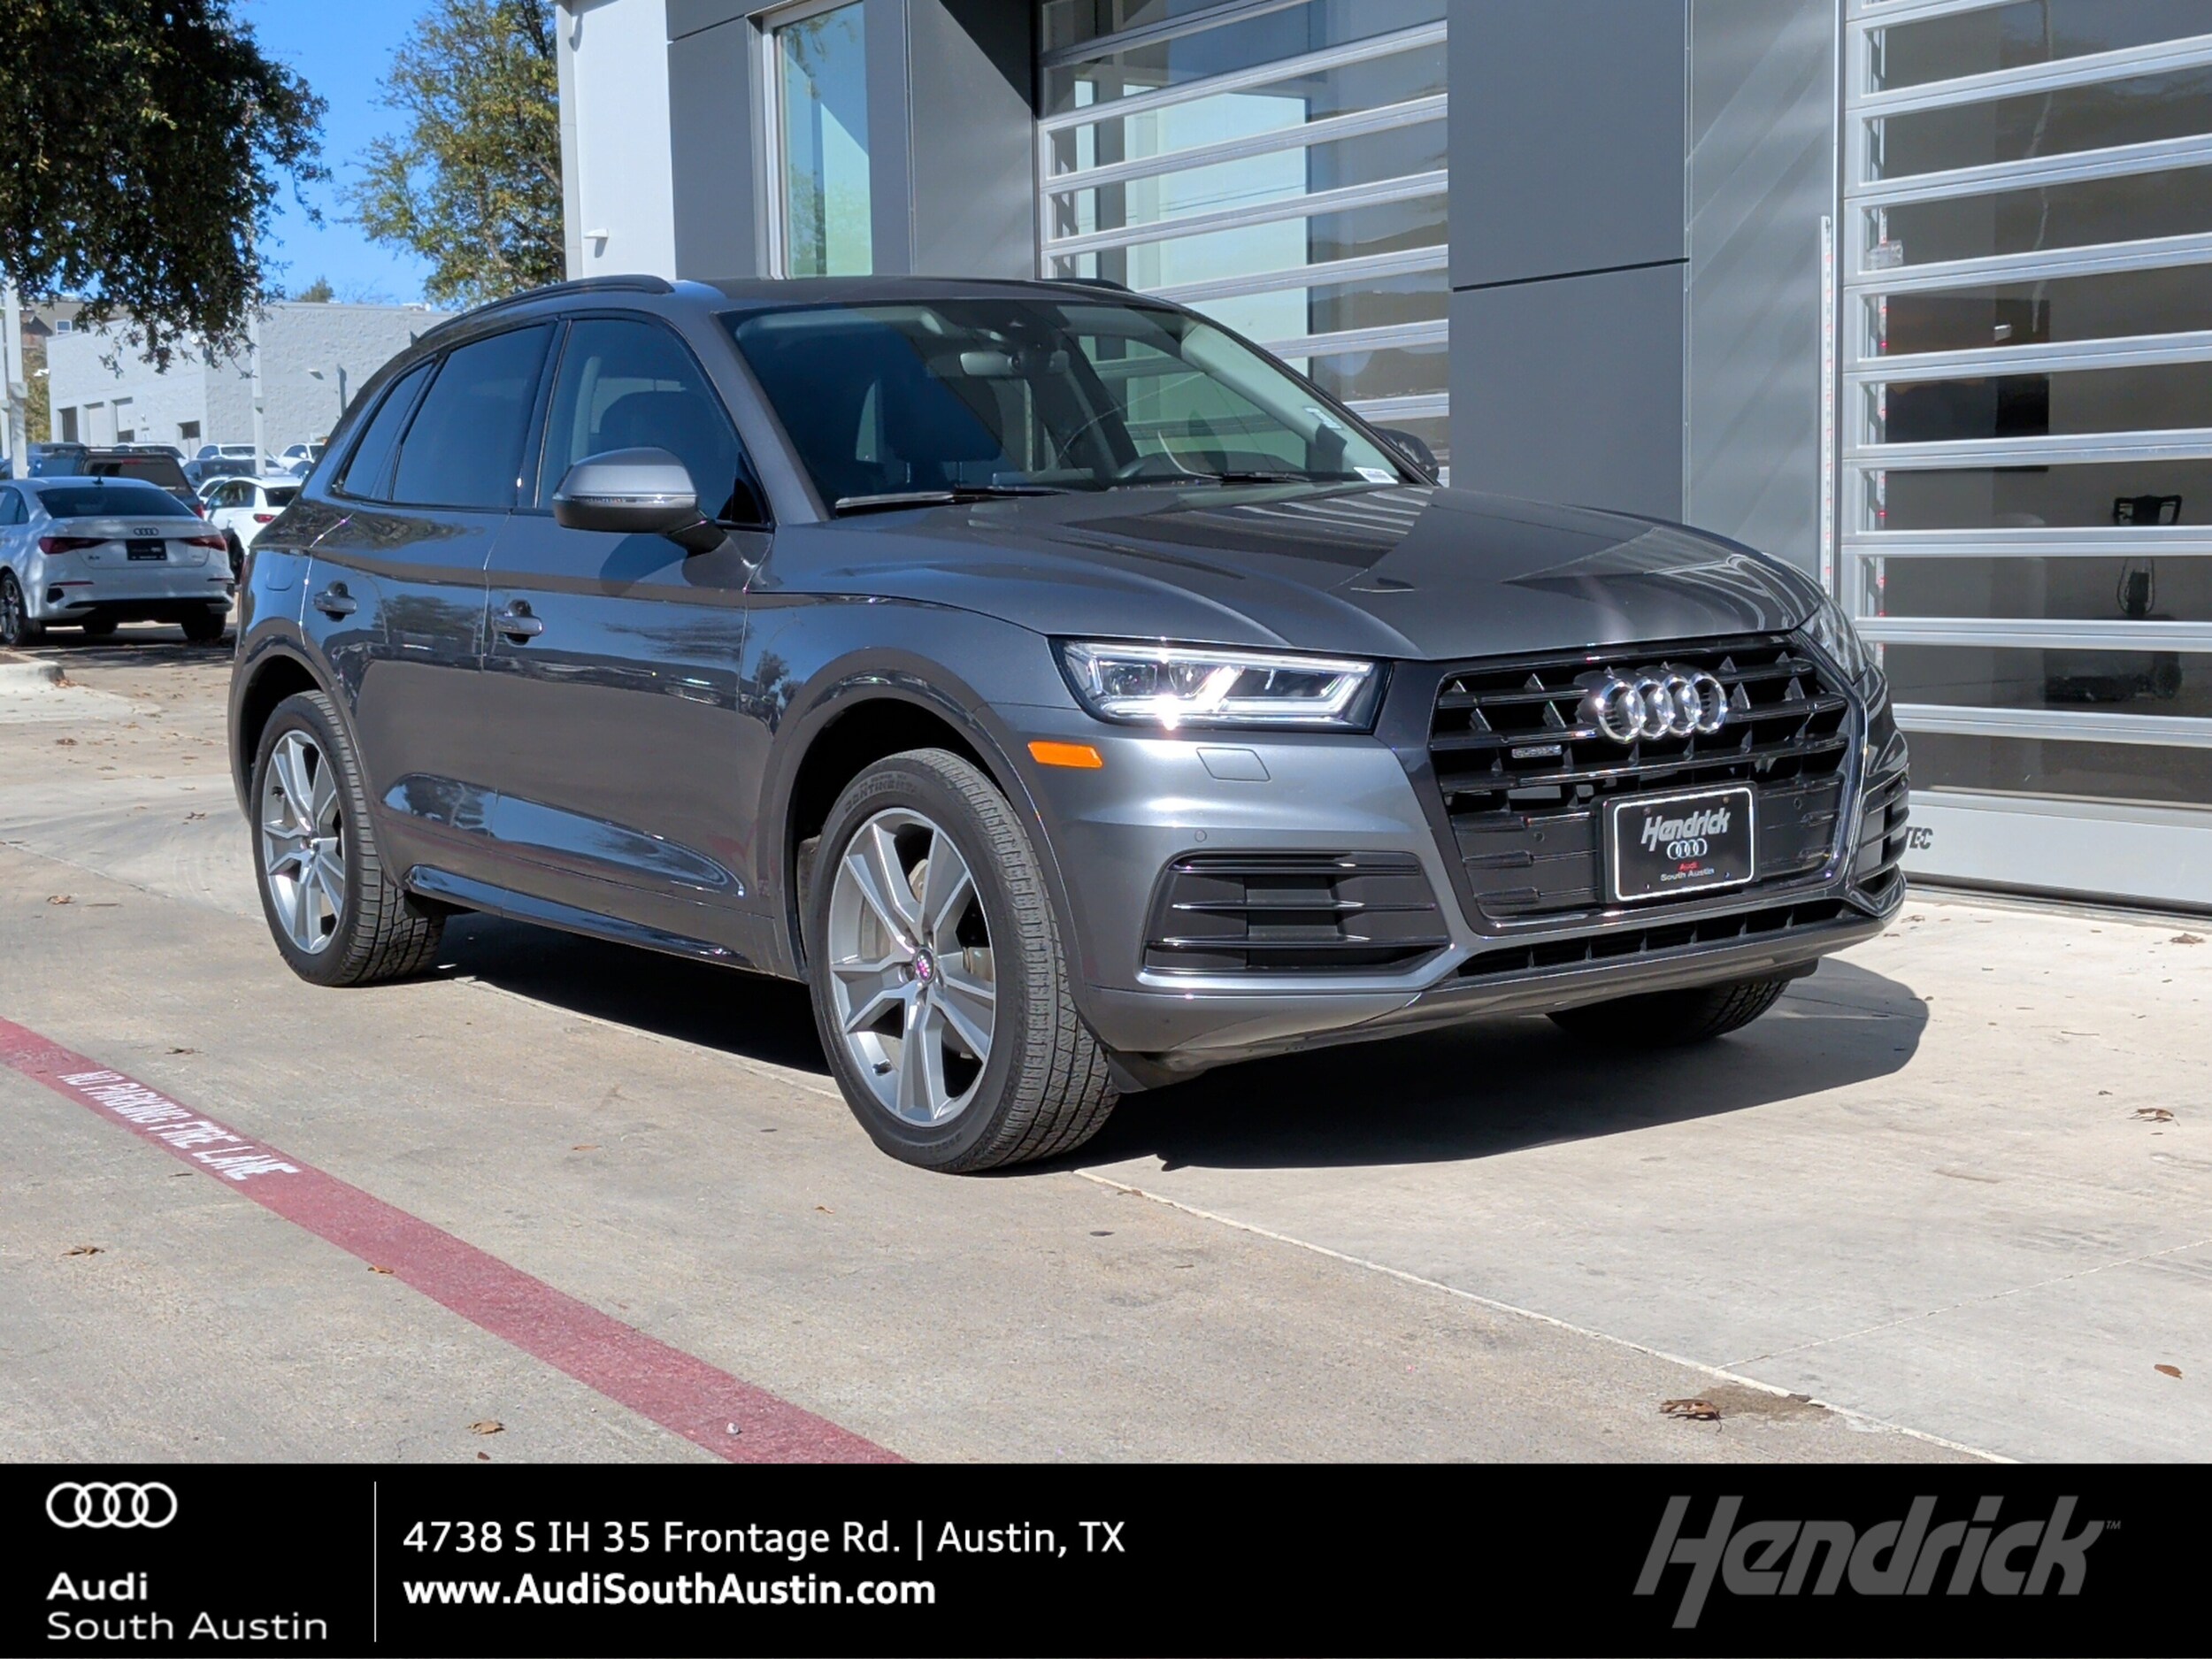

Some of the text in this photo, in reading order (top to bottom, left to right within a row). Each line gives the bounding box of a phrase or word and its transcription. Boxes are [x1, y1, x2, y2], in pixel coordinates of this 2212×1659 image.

[1640, 807, 1732, 852] Hendrick
[1661, 867, 1715, 881] South Austin
[58, 1071, 302, 1180] NO PARKING FIRE LANE
